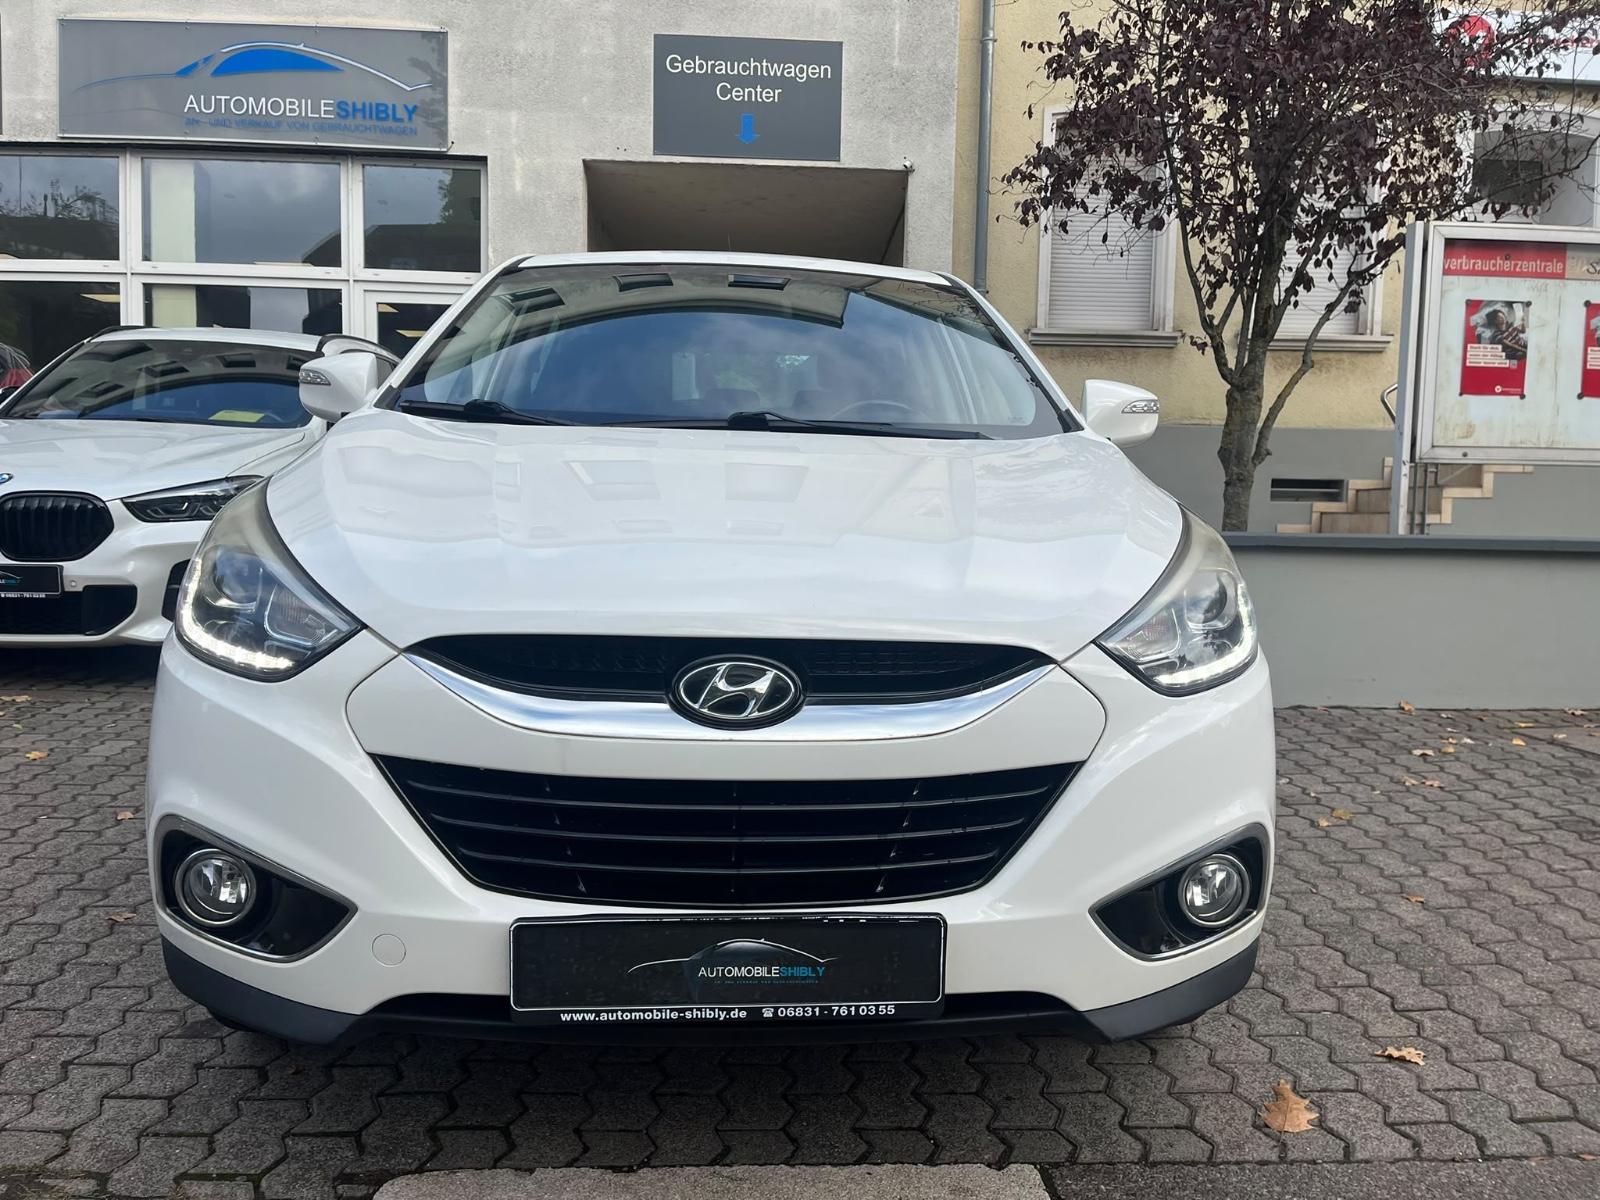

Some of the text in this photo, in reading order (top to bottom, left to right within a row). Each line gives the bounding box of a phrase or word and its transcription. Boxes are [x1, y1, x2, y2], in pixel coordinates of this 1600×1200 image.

[665, 54, 831, 82] Gebrauchtwagen
[716, 82, 782, 102] Center
[1444, 255, 1564, 274] verbraucherzentrale
[560, 1008, 748, 1022] www.automobile-shibly.de
